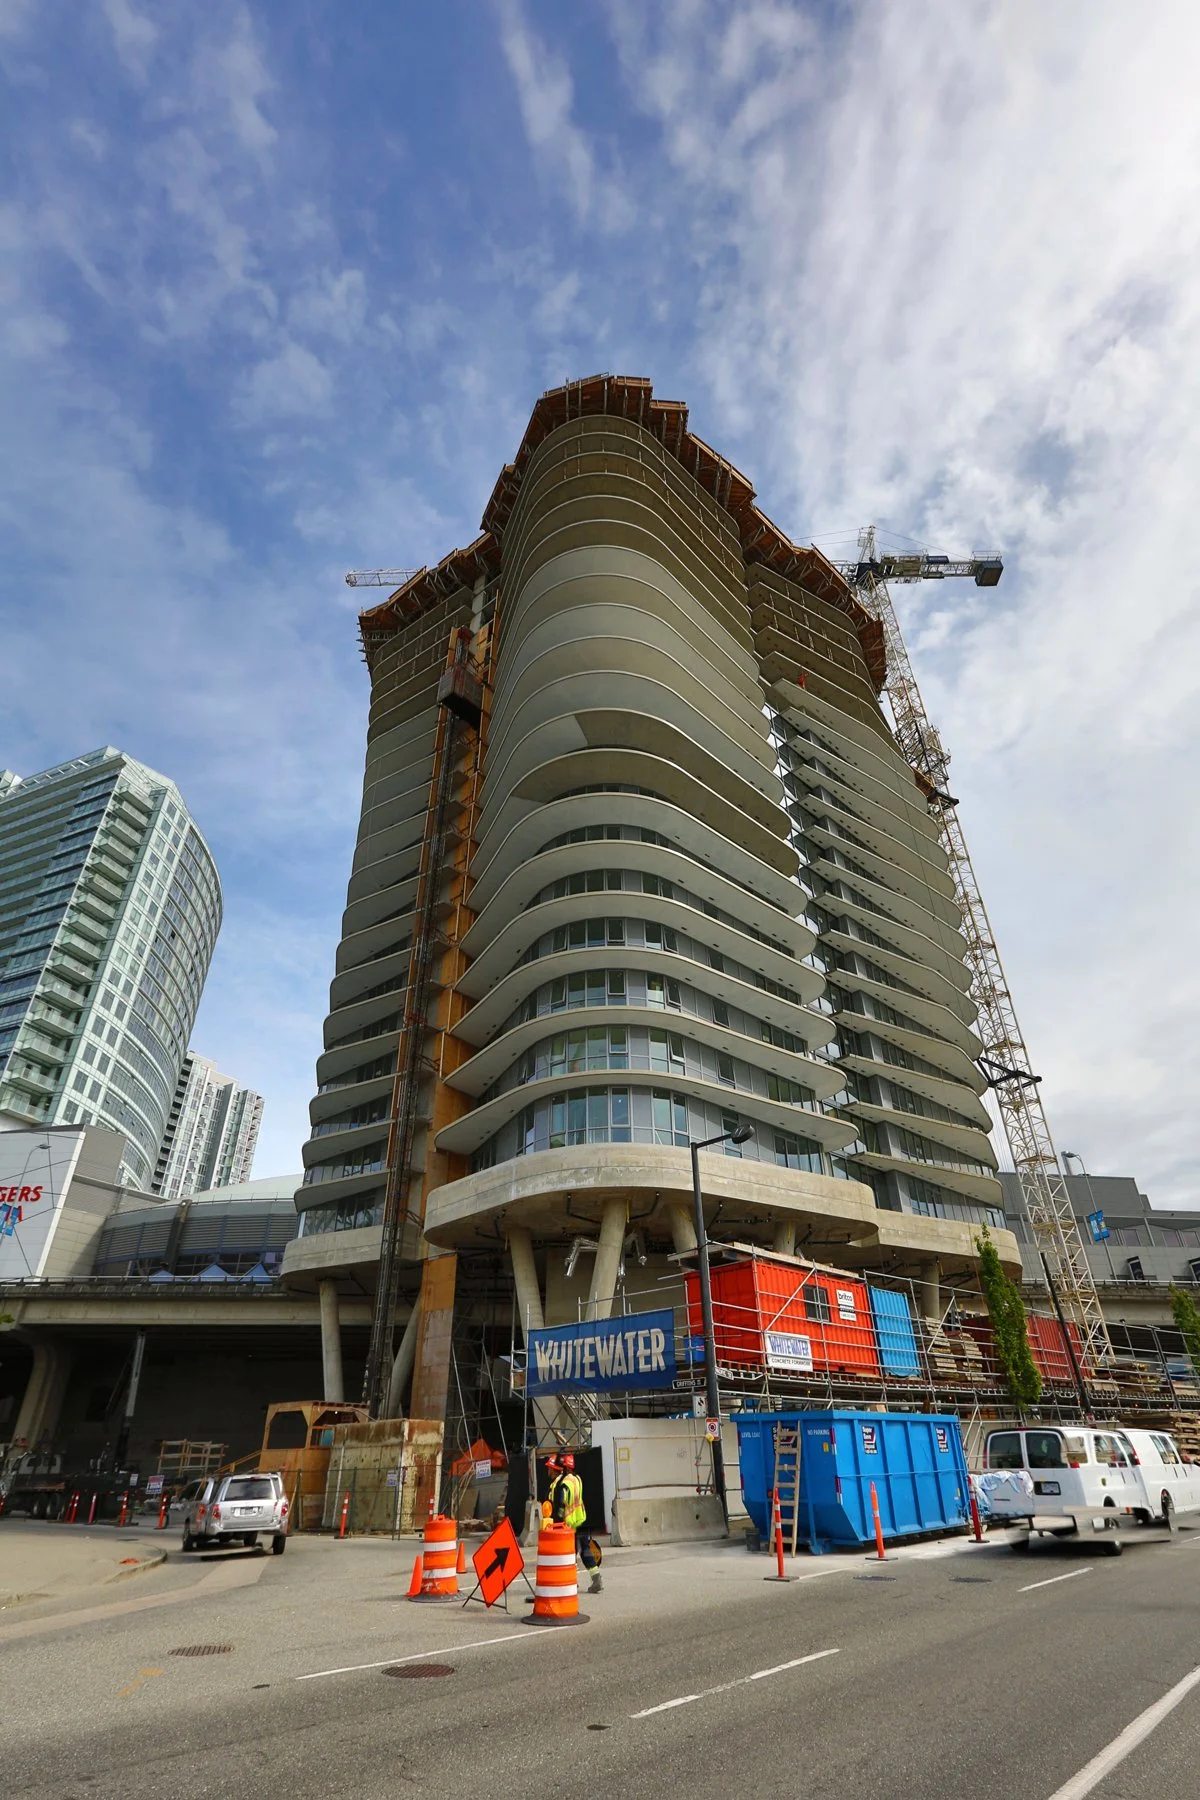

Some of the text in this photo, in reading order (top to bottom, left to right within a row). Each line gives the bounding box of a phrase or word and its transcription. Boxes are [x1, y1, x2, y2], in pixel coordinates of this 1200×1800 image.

[534, 1328, 665, 1383] WHITEWATER
[768, 1335, 810, 1357] WHITEWATER
[771, 1357, 791, 1365] CONCRETE
